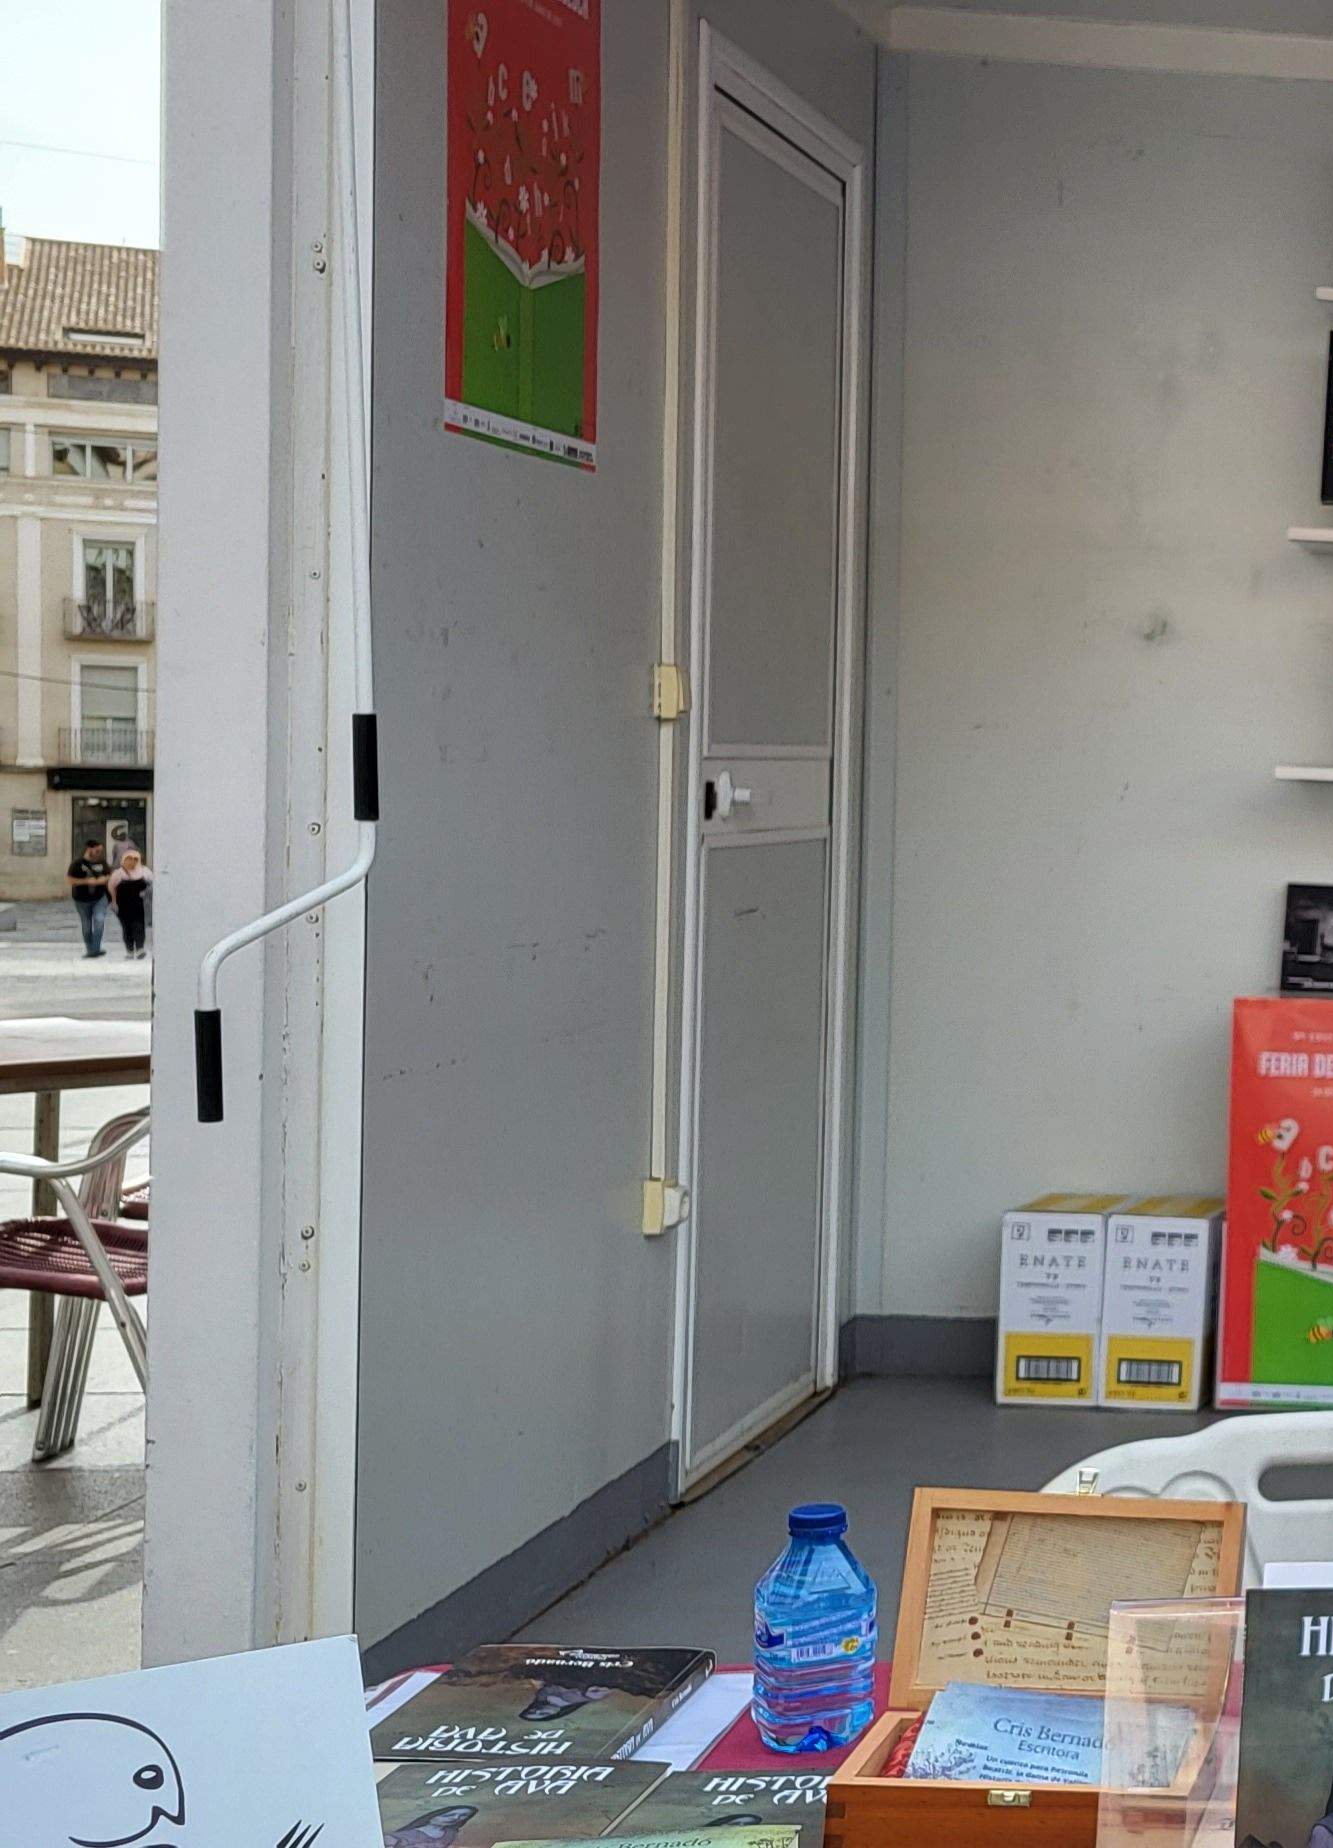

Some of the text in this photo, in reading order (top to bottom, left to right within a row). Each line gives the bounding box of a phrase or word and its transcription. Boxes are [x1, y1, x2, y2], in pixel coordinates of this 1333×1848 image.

[1258, 1050, 1309, 1079] FERIA
[1019, 1253, 1087, 1269] ENATE
[1122, 1255, 1190, 1273] ENATE
[427, 1725, 565, 1742] DE AVA
[993, 1716, 1033, 1738] Cris
[391, 1737, 573, 1756] HISTORIA
[1018, 1739, 1081, 1762] Escritora
[425, 1765, 615, 1787] HISTORIA
[430, 1778, 579, 1798] DE AVA
[711, 1791, 755, 1806] DE
